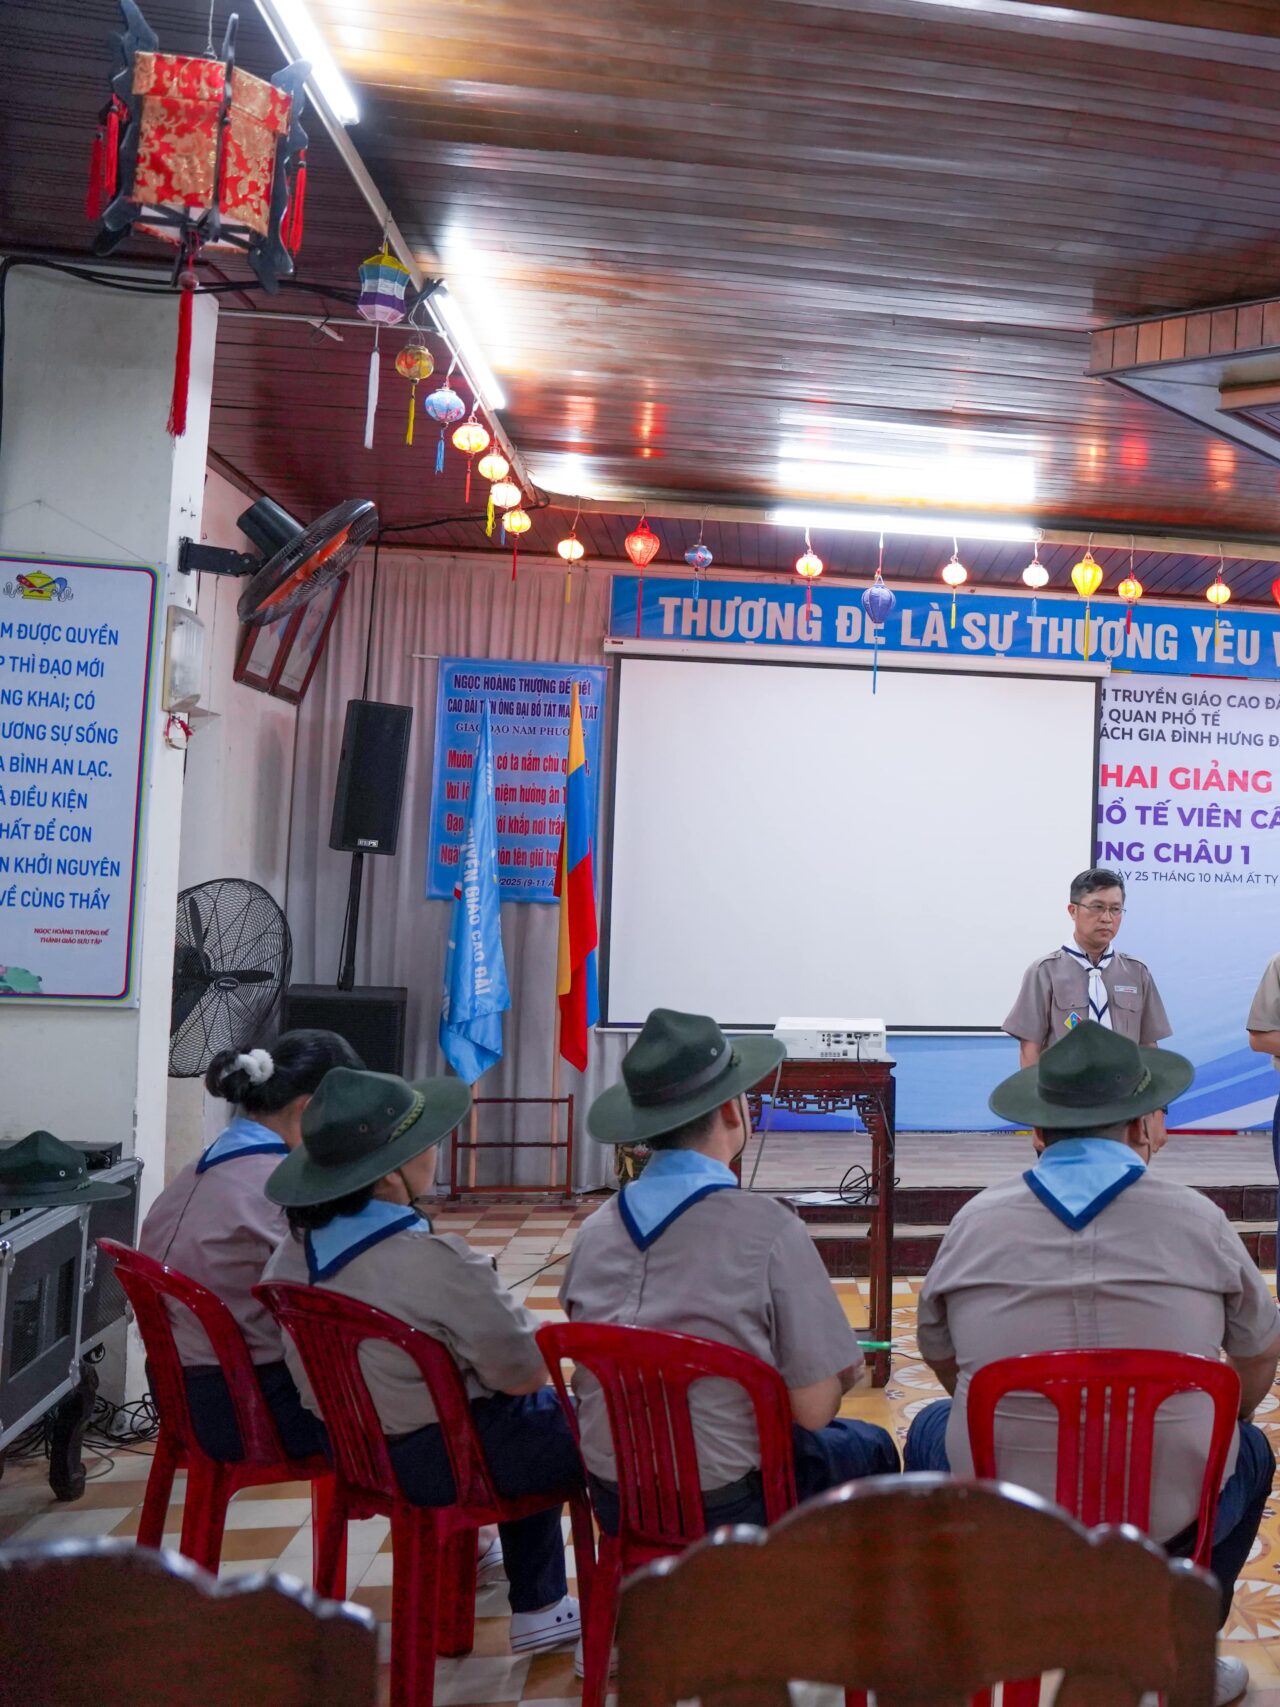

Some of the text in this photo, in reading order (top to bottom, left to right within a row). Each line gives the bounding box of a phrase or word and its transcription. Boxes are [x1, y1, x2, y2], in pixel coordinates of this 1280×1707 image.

[17, 623, 62, 645] ĐƯỢC
[66, 624, 119, 646] QUYỀN
[659, 596, 822, 644] THƯỢNG
[901, 602, 948, 648] LÀ
[961, 611, 1019, 657] SỰ
[1026, 616, 1178, 661] THƯƠNG
[1191, 620, 1260, 665] YÊU
[9, 653, 104, 679] THÌ ĐẠO MỚI
[454, 674, 572, 696] NGỌC HOÀNG THƯỢNG ĐẾ
[27, 690, 70, 711] KHAI;
[74, 691, 95, 710] CÓ
[447, 698, 462, 713] CAO
[516, 703, 529, 719] ĐẠI
[1112, 687, 1177, 705] TRUYỀN
[1182, 691, 1222, 707] GIÁO
[1227, 695, 1260, 709] CAO
[1108, 708, 1156, 724] QUAN
[1162, 706, 1197, 725] PHỔ
[1201, 709, 1221, 727] TẾ
[50, 724, 73, 746] SỰ
[75, 721, 119, 744] SỐNG
[512, 726, 536, 735] NAM
[1138, 728, 1166, 742] GIA
[1171, 727, 1212, 744] ĐÌNH
[1217, 732, 1264, 747] HƯNG
[9, 753, 112, 781] BÌNH AN LẠC.
[497, 752, 507, 770] có
[510, 753, 519, 771] ta
[521, 750, 540, 772] nắm
[543, 752, 559, 773] chủ
[1101, 760, 1273, 793] HAI GIẢNG
[10, 784, 88, 812] ĐIỀU KIỆN
[446, 782, 560, 806] Vui niệm hưởng ân
[447, 812, 546, 836] Đạo khắp nơi
[1135, 799, 1172, 826] TẾ
[1176, 803, 1242, 828] VIÊN
[34, 818, 56, 841] ĐỂ
[59, 825, 92, 843] CON
[513, 848, 544, 868] tên giữ
[1154, 839, 1232, 865] CHÂU
[1241, 845, 1250, 865] 1
[14, 853, 52, 875] KHỞI
[56, 857, 120, 878] NGUYÊN
[1135, 871, 1149, 881] 25
[1152, 870, 1196, 883] THÁNG
[1200, 873, 1211, 883] 10
[1215, 871, 1243, 884] NĂM
[21, 888, 65, 909] CÙNG
[69, 888, 110, 910] THẦY
